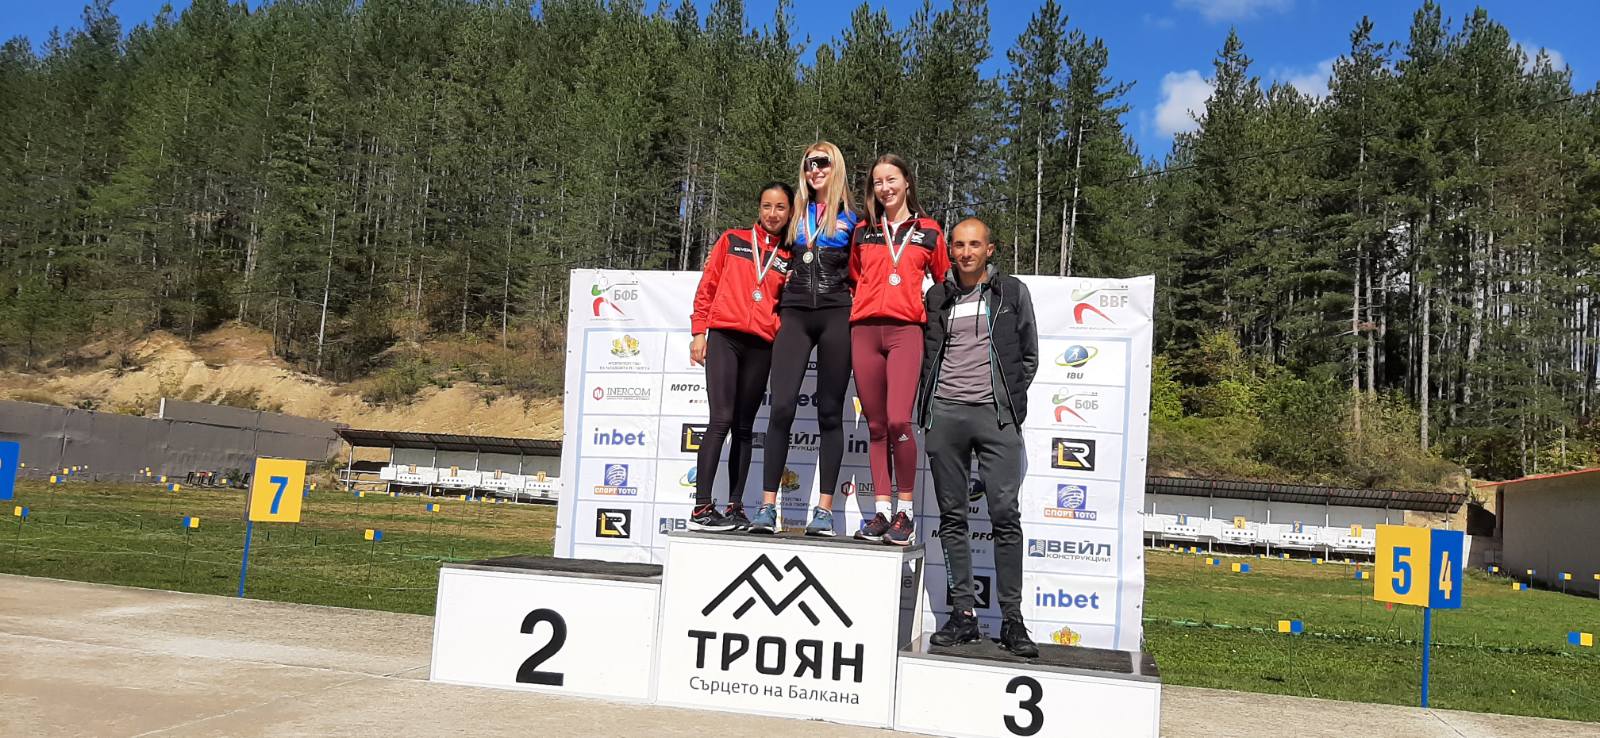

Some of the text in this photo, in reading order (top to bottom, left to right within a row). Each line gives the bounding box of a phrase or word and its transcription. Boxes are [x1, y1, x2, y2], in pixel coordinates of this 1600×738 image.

[614, 289, 639, 301] БФБ
[1099, 295, 1128, 308] BBF
[1066, 372, 1084, 380] IBU
[606, 387, 651, 397] INERCOM
[670, 384, 709, 392] MOTO-
[1074, 400, 1099, 410] БФБ
[593, 427, 646, 446] inbet
[270, 475, 289, 514] 7
[594, 487, 617, 495] СПОРТ
[1044, 510, 1096, 519] СПОРТ ТОТО
[1047, 540, 1111, 556] ВЕЙЛ
[1047, 553, 1111, 562] КОНСТРУКЦИИ
[1392, 546, 1412, 595] 5
[1439, 551, 1452, 600] 4
[1036, 586, 1099, 609] inbet
[516, 608, 567, 686] 2
[687, 629, 864, 683] ТРОЯН
[689, 676, 860, 704] Сърцето на Балкана
[1003, 675, 1044, 737] 3
